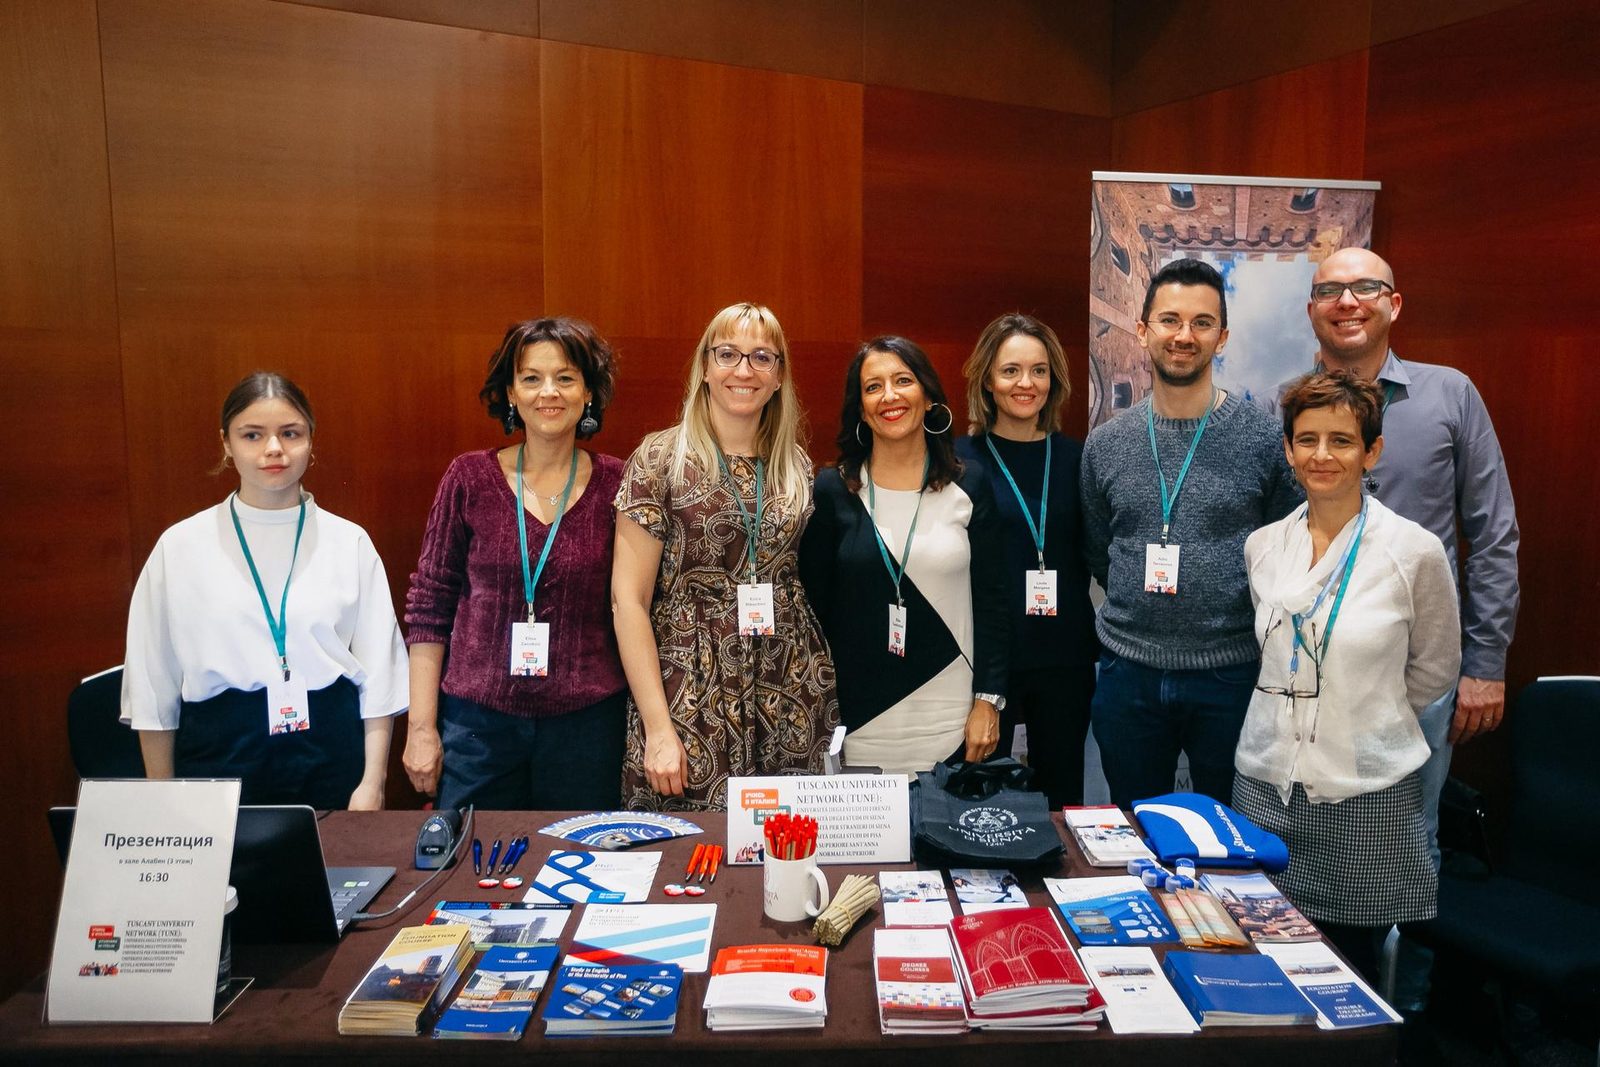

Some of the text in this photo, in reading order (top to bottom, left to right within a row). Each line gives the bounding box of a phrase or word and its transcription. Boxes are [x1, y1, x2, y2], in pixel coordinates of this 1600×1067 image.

[796, 780, 898, 790] TUSCANY UNIVERSITY
[796, 795, 844, 804] NETWORK
[104, 833, 213, 850] Презентация
[139, 872, 168, 882] 16:30
[127, 920, 195, 928] TUSCANY UNIVERSITY
[984, 985, 1007, 994] Courses
[1015, 980, 1037, 988] English
[1306, 984, 1352, 992] FOUNDATION
